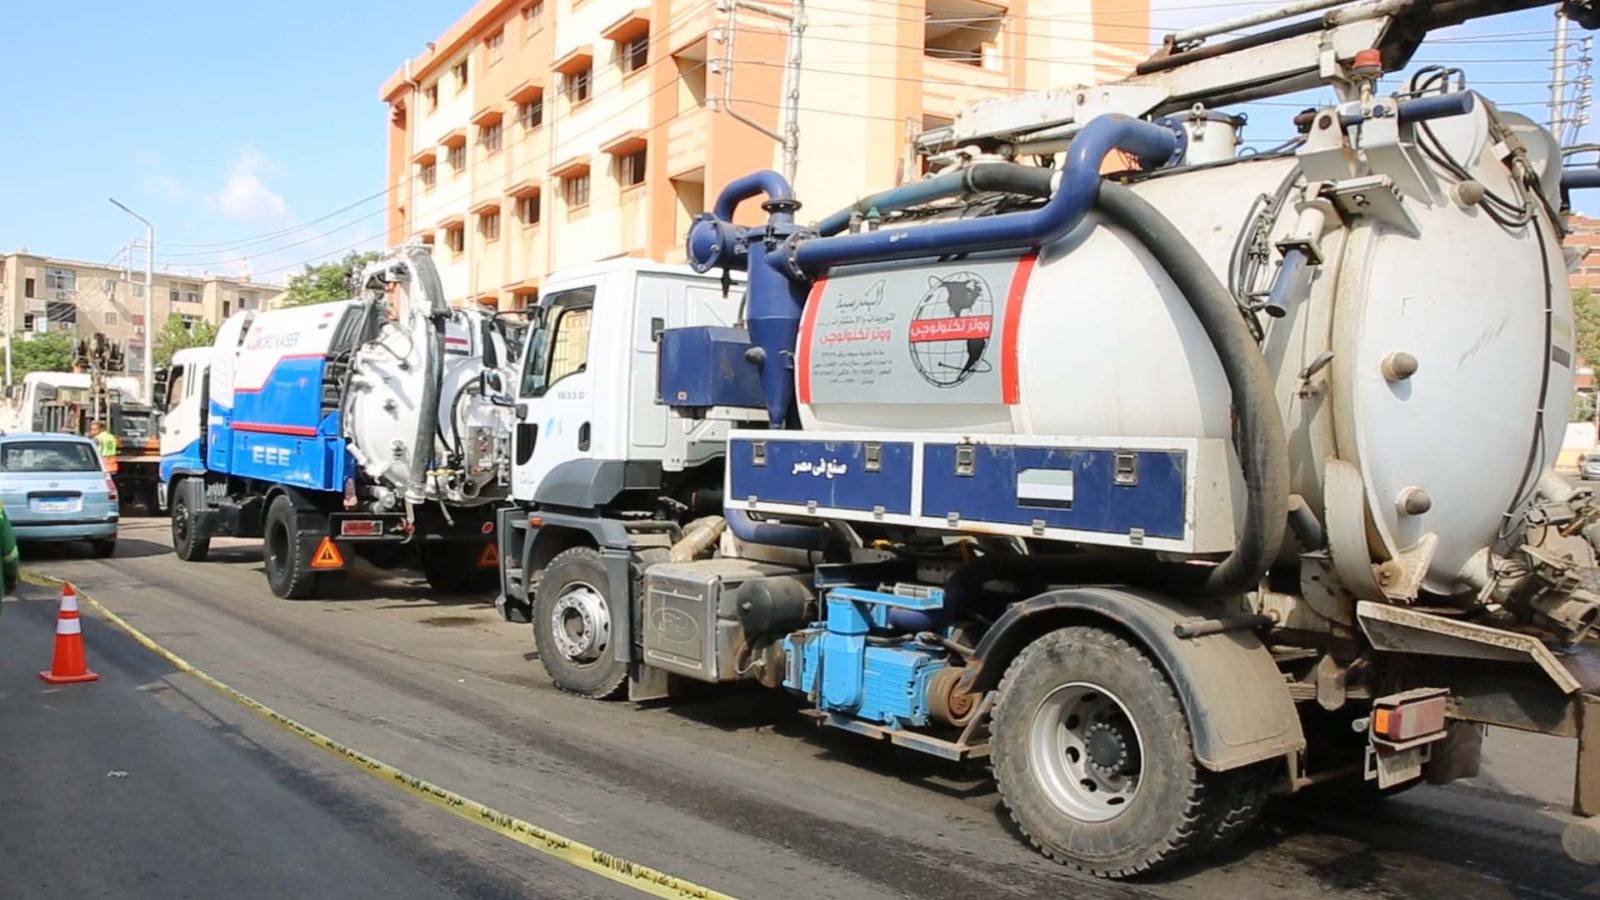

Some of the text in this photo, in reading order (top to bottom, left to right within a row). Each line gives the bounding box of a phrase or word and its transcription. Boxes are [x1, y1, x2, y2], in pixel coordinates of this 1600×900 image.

[252, 445, 291, 467] EEE
[792, 461, 812, 475] مصر
[826, 458, 847, 479] صنع
[592, 850, 633, 876] CAUTION
